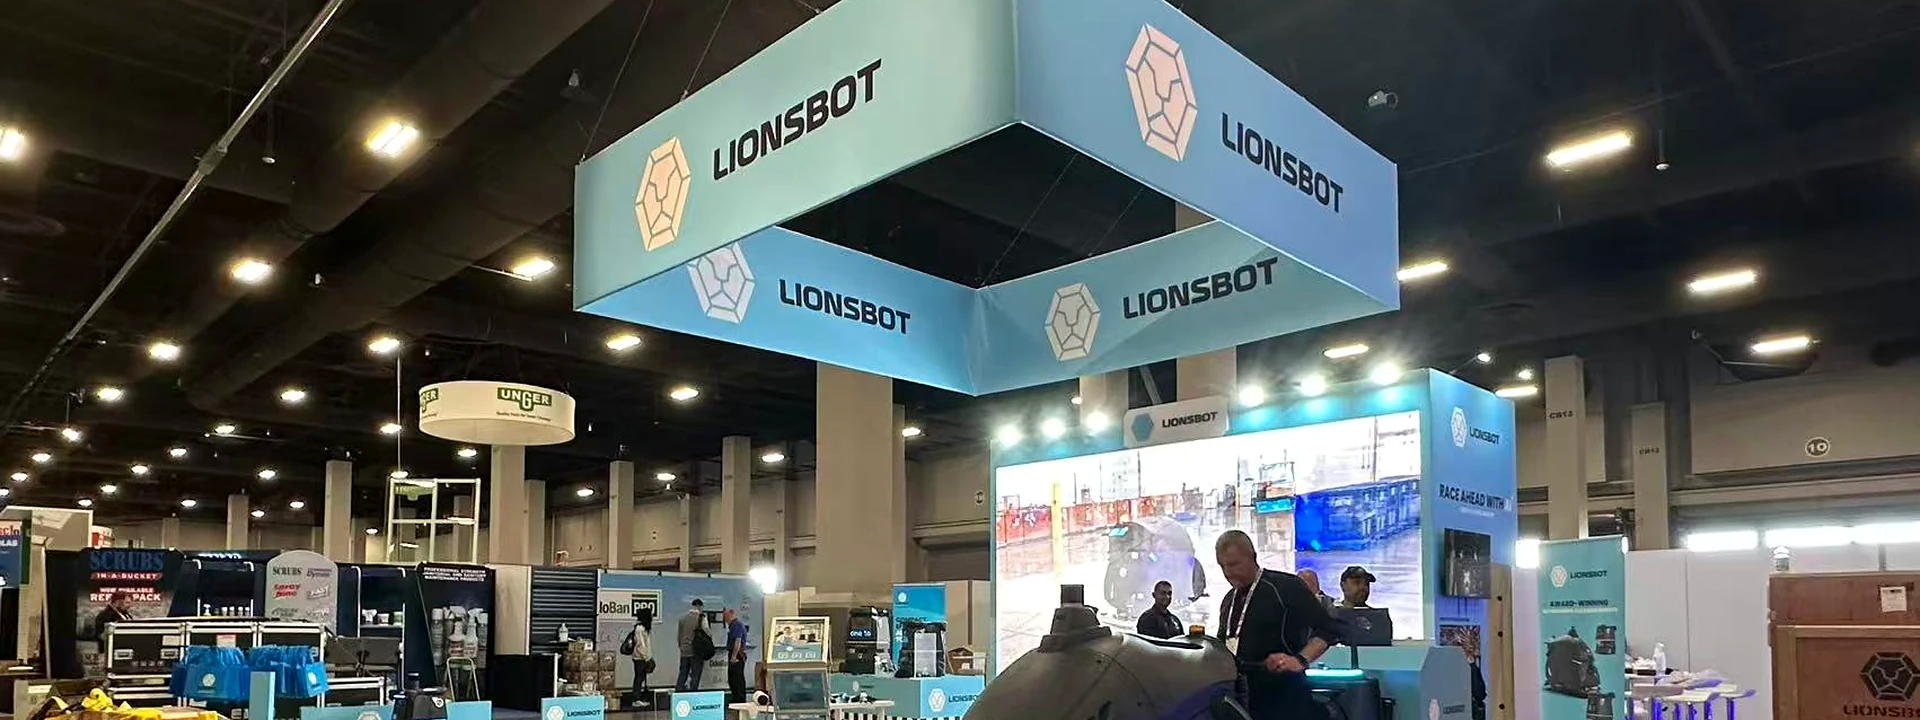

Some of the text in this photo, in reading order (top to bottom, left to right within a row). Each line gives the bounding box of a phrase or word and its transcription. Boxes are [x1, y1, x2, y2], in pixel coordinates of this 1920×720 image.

[713, 58, 882, 180] LIONSBOT
[1222, 112, 1343, 213] LIONSBOT
[1123, 257, 1278, 319] LIONSBOT
[779, 279, 911, 334] LIONSBOT
[501, 389, 550, 409] UNGER
[1162, 411, 1218, 428] LIONSBOT
[1469, 426, 1500, 444] LIONSBOT
[1809, 442, 1827, 453] 10
[1439, 484, 1460, 502] RACE
[1460, 490, 1485, 507] AHEAD
[1486, 494, 1504, 510] WITH
[90, 551, 164, 570] SCRUBS
[1570, 570, 1607, 579] LIONSBOT
[132, 594, 161, 602] PACK
[567, 709, 601, 717] LIONSBOT
